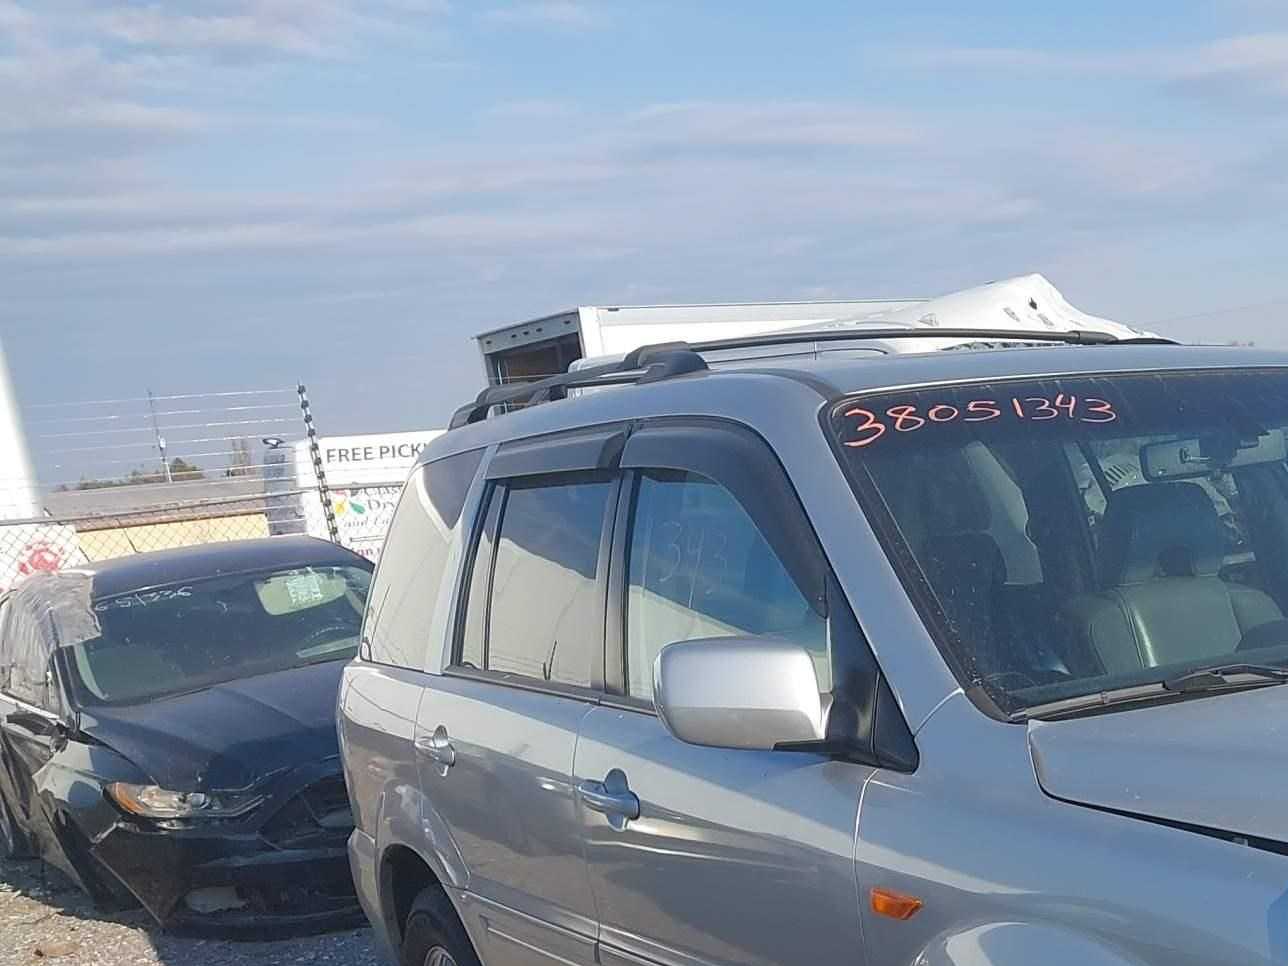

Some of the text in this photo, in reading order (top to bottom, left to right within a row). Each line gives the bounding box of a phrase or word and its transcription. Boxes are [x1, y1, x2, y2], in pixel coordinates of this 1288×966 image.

[844, 394, 1117, 446] 38051343
[327, 443, 427, 463] FREE PICK
